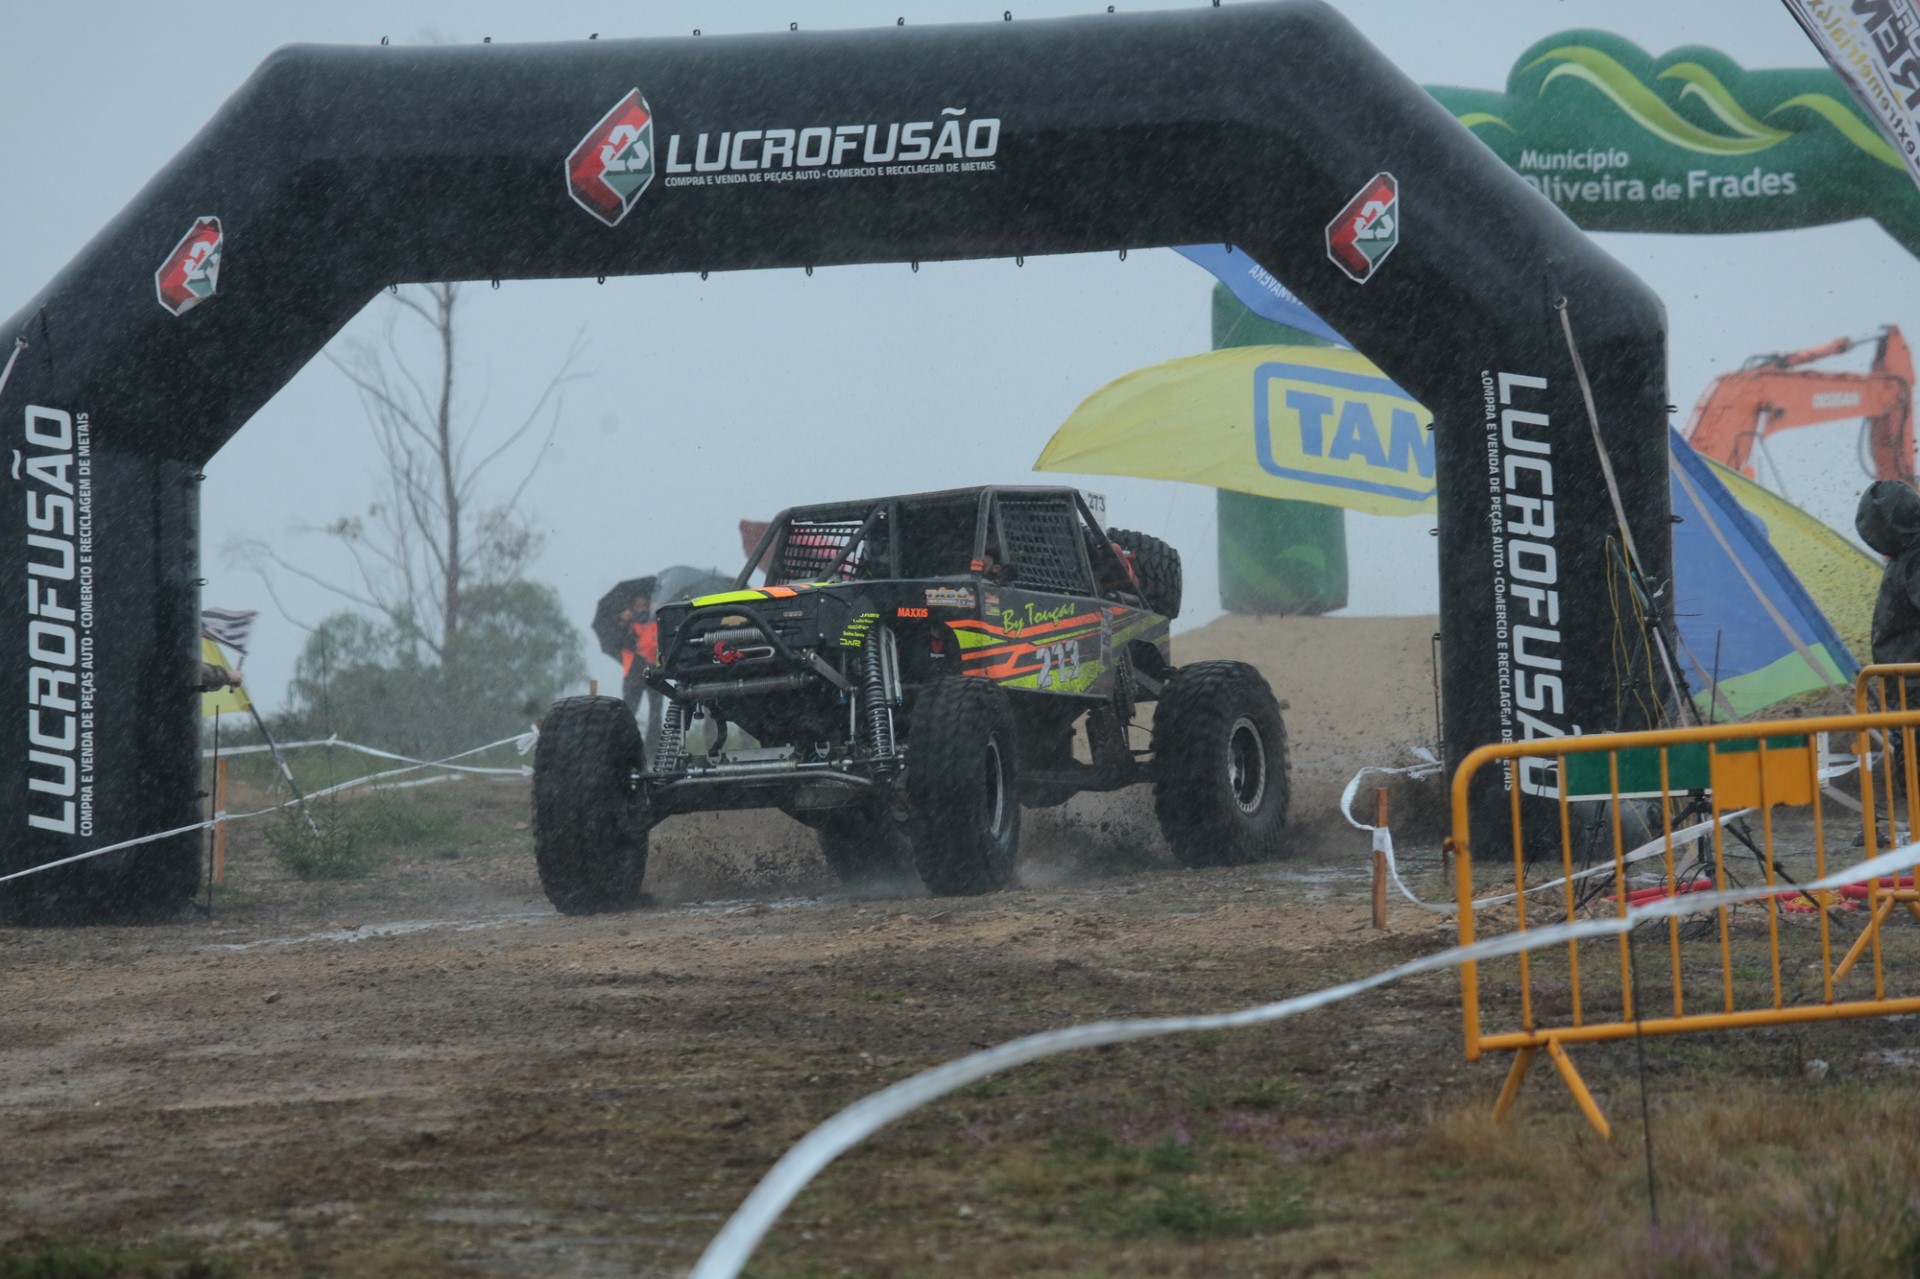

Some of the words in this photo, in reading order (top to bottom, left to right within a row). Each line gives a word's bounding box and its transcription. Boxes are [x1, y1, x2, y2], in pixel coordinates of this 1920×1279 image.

[664, 107, 1001, 174] LUCROFUSÃO
[665, 176, 705, 187] COMPRA
[707, 175, 713, 185] E
[715, 173, 747, 184] VENDA
[749, 172, 762, 183] DE
[764, 171, 793, 183] PEÇAS
[795, 169, 820, 180] AUTO
[827, 167, 875, 178] COMERCIO
[878, 166, 884, 176] E
[886, 163, 944, 175] RECICLAGEM
[948, 162, 959, 172] DE
[961, 160, 996, 172] METAIS
[1651, 178, 1682, 200] de
[1687, 167, 1797, 199] Frades
[77, 412, 90, 457] METAIS
[78, 459, 91, 475] DE
[1486, 432, 1499, 475] VENDA
[1087, 493, 1106, 512] 273
[1489, 477, 1501, 493] DE
[78, 478, 92, 553] RECICLAGEM
[1487, 496, 1503, 534] PEÇAS
[79, 555, 92, 563] E
[1492, 536, 1504, 569] AUTO
[79, 566, 92, 628] COMERCIO
[897, 607, 928, 618] MAXXIS
[1493, 577, 1508, 639] COMERCIO
[11, 404, 76, 835] LUCROFUSÃO
[1002, 609, 1026, 638] By
[80, 636, 93, 670] AUTO
[1036, 639, 1081, 688] 273
[1498, 642, 1509, 650] E
[80, 671, 96, 710] PEÇAS
[1497, 652, 1511, 726] RECICLAGEM
[80, 712, 93, 729] DE
[80, 731, 93, 773] VENDA
[80, 774, 93, 783] E
[1503, 756, 1513, 791] ETAIS
[80, 785, 93, 837] COMPRA
